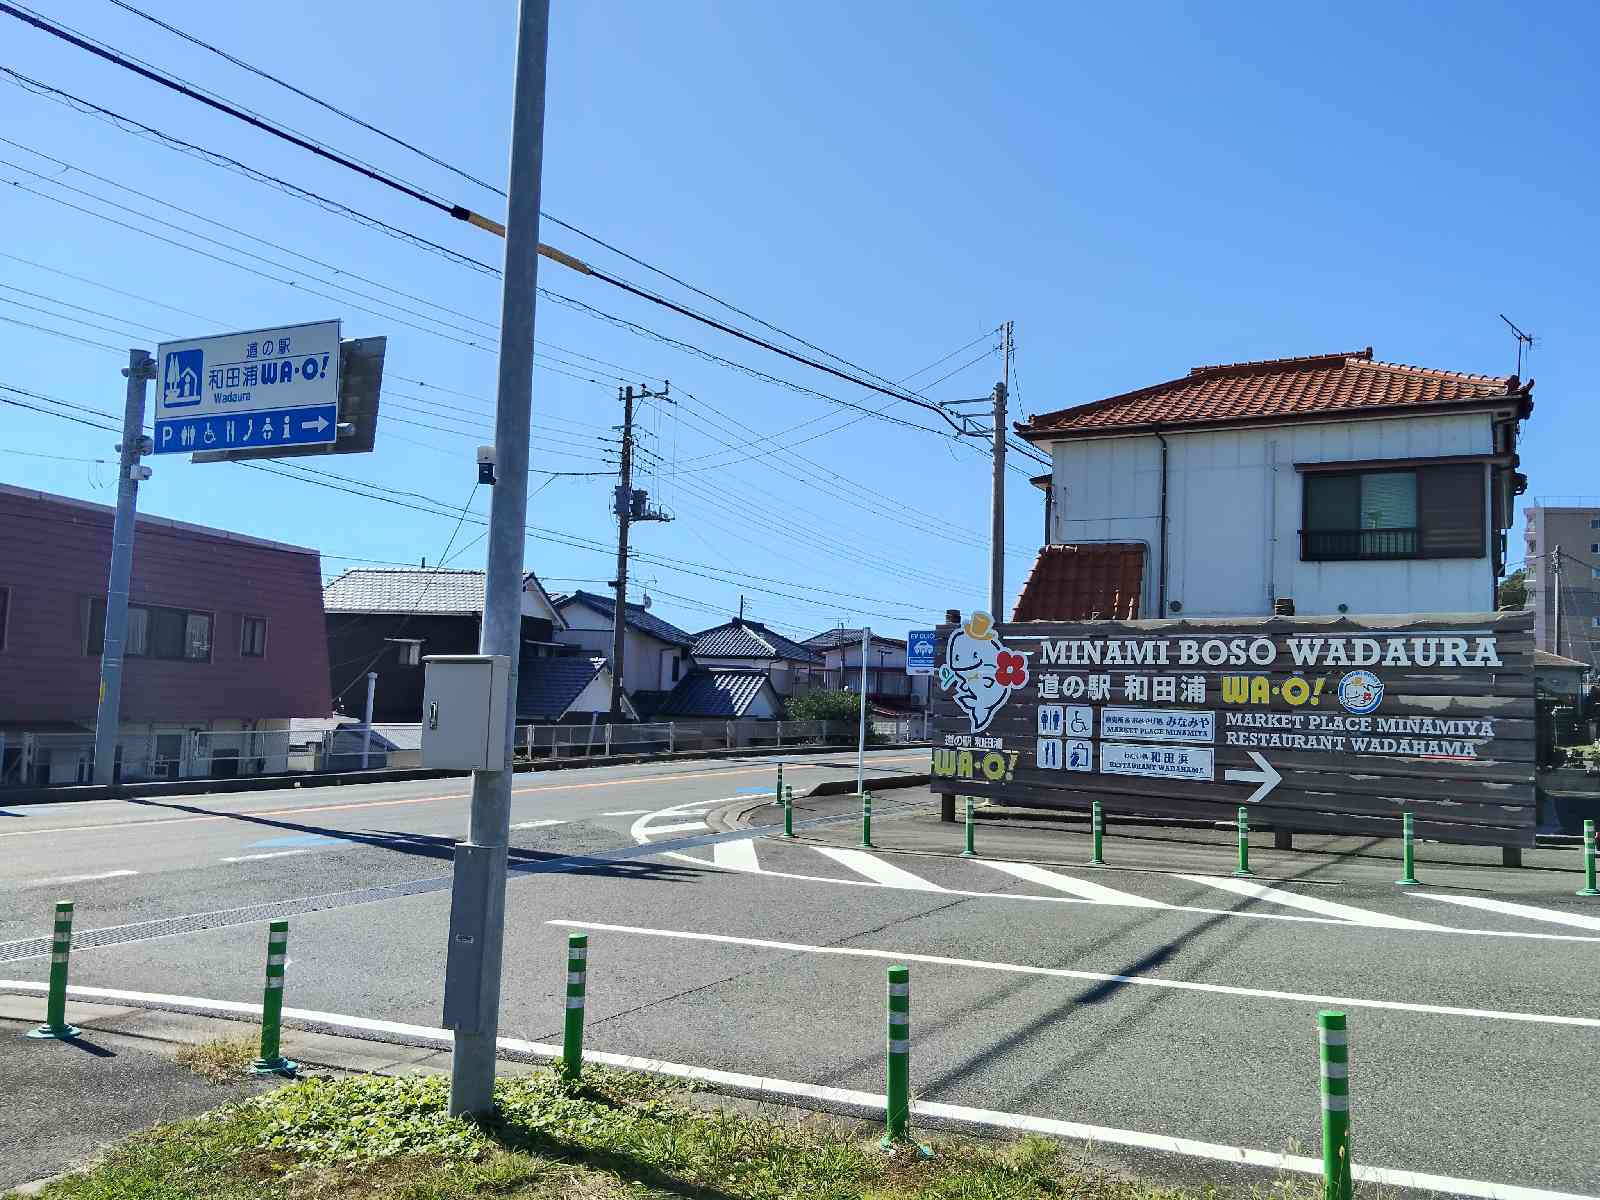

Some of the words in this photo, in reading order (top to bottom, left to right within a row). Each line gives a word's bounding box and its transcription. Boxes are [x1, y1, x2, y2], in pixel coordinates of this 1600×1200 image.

[247, 336, 291, 359] 道の駅
[208, 366, 258, 390] 和田浦
[213, 391, 252, 404] Wadaura
[1039, 640, 1169, 666] MINAMI
[1178, 637, 1277, 666] BOSO
[1286, 637, 1503, 667] WADAURA
[1037, 674, 1111, 701] 道の駅
[1124, 675, 1207, 704] 和田浦
[1106, 726, 1139, 735] MARKET
[1140, 727, 1164, 735] PLACE
[1166, 716, 1210, 729] みなみや
[1225, 713, 1304, 730] MARKET
[1308, 715, 1372, 732] PLACE
[1376, 719, 1496, 738] MINAMIYA
[1225, 731, 1346, 751] RESTAURANT
[1350, 737, 1478, 758] WADAHAMA
[1109, 761, 1157, 771] RESTAURANT
